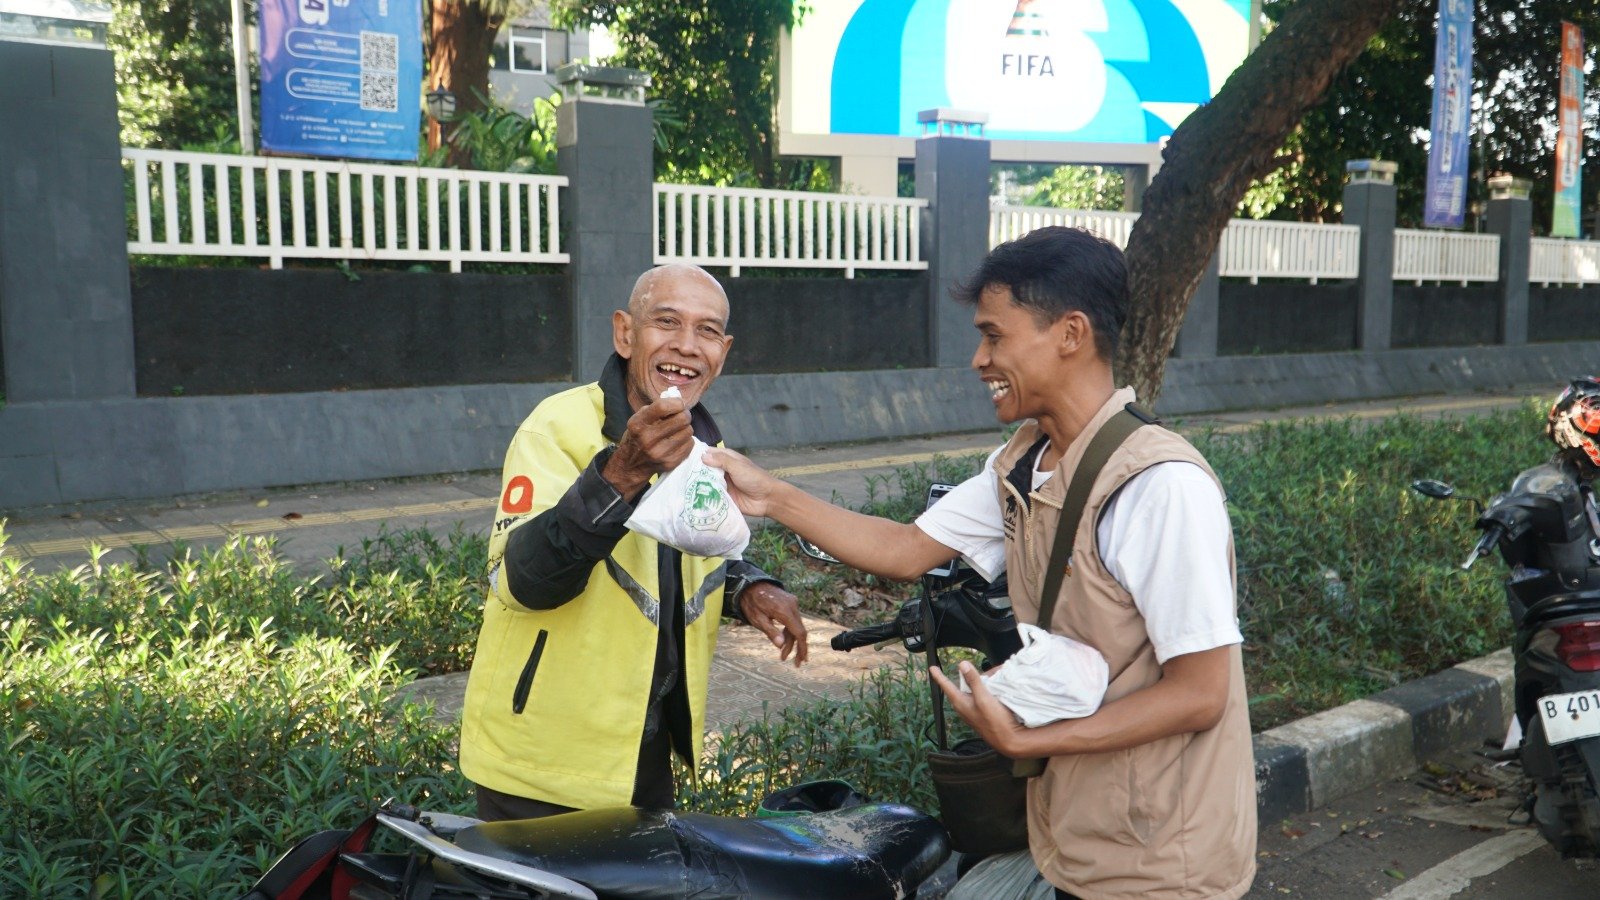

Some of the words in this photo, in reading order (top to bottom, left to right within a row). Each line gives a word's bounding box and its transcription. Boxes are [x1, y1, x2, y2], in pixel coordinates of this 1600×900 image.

[1002, 54, 1054, 76] FIFA
[1545, 701, 1557, 718] B
[1567, 694, 1600, 713] 401
